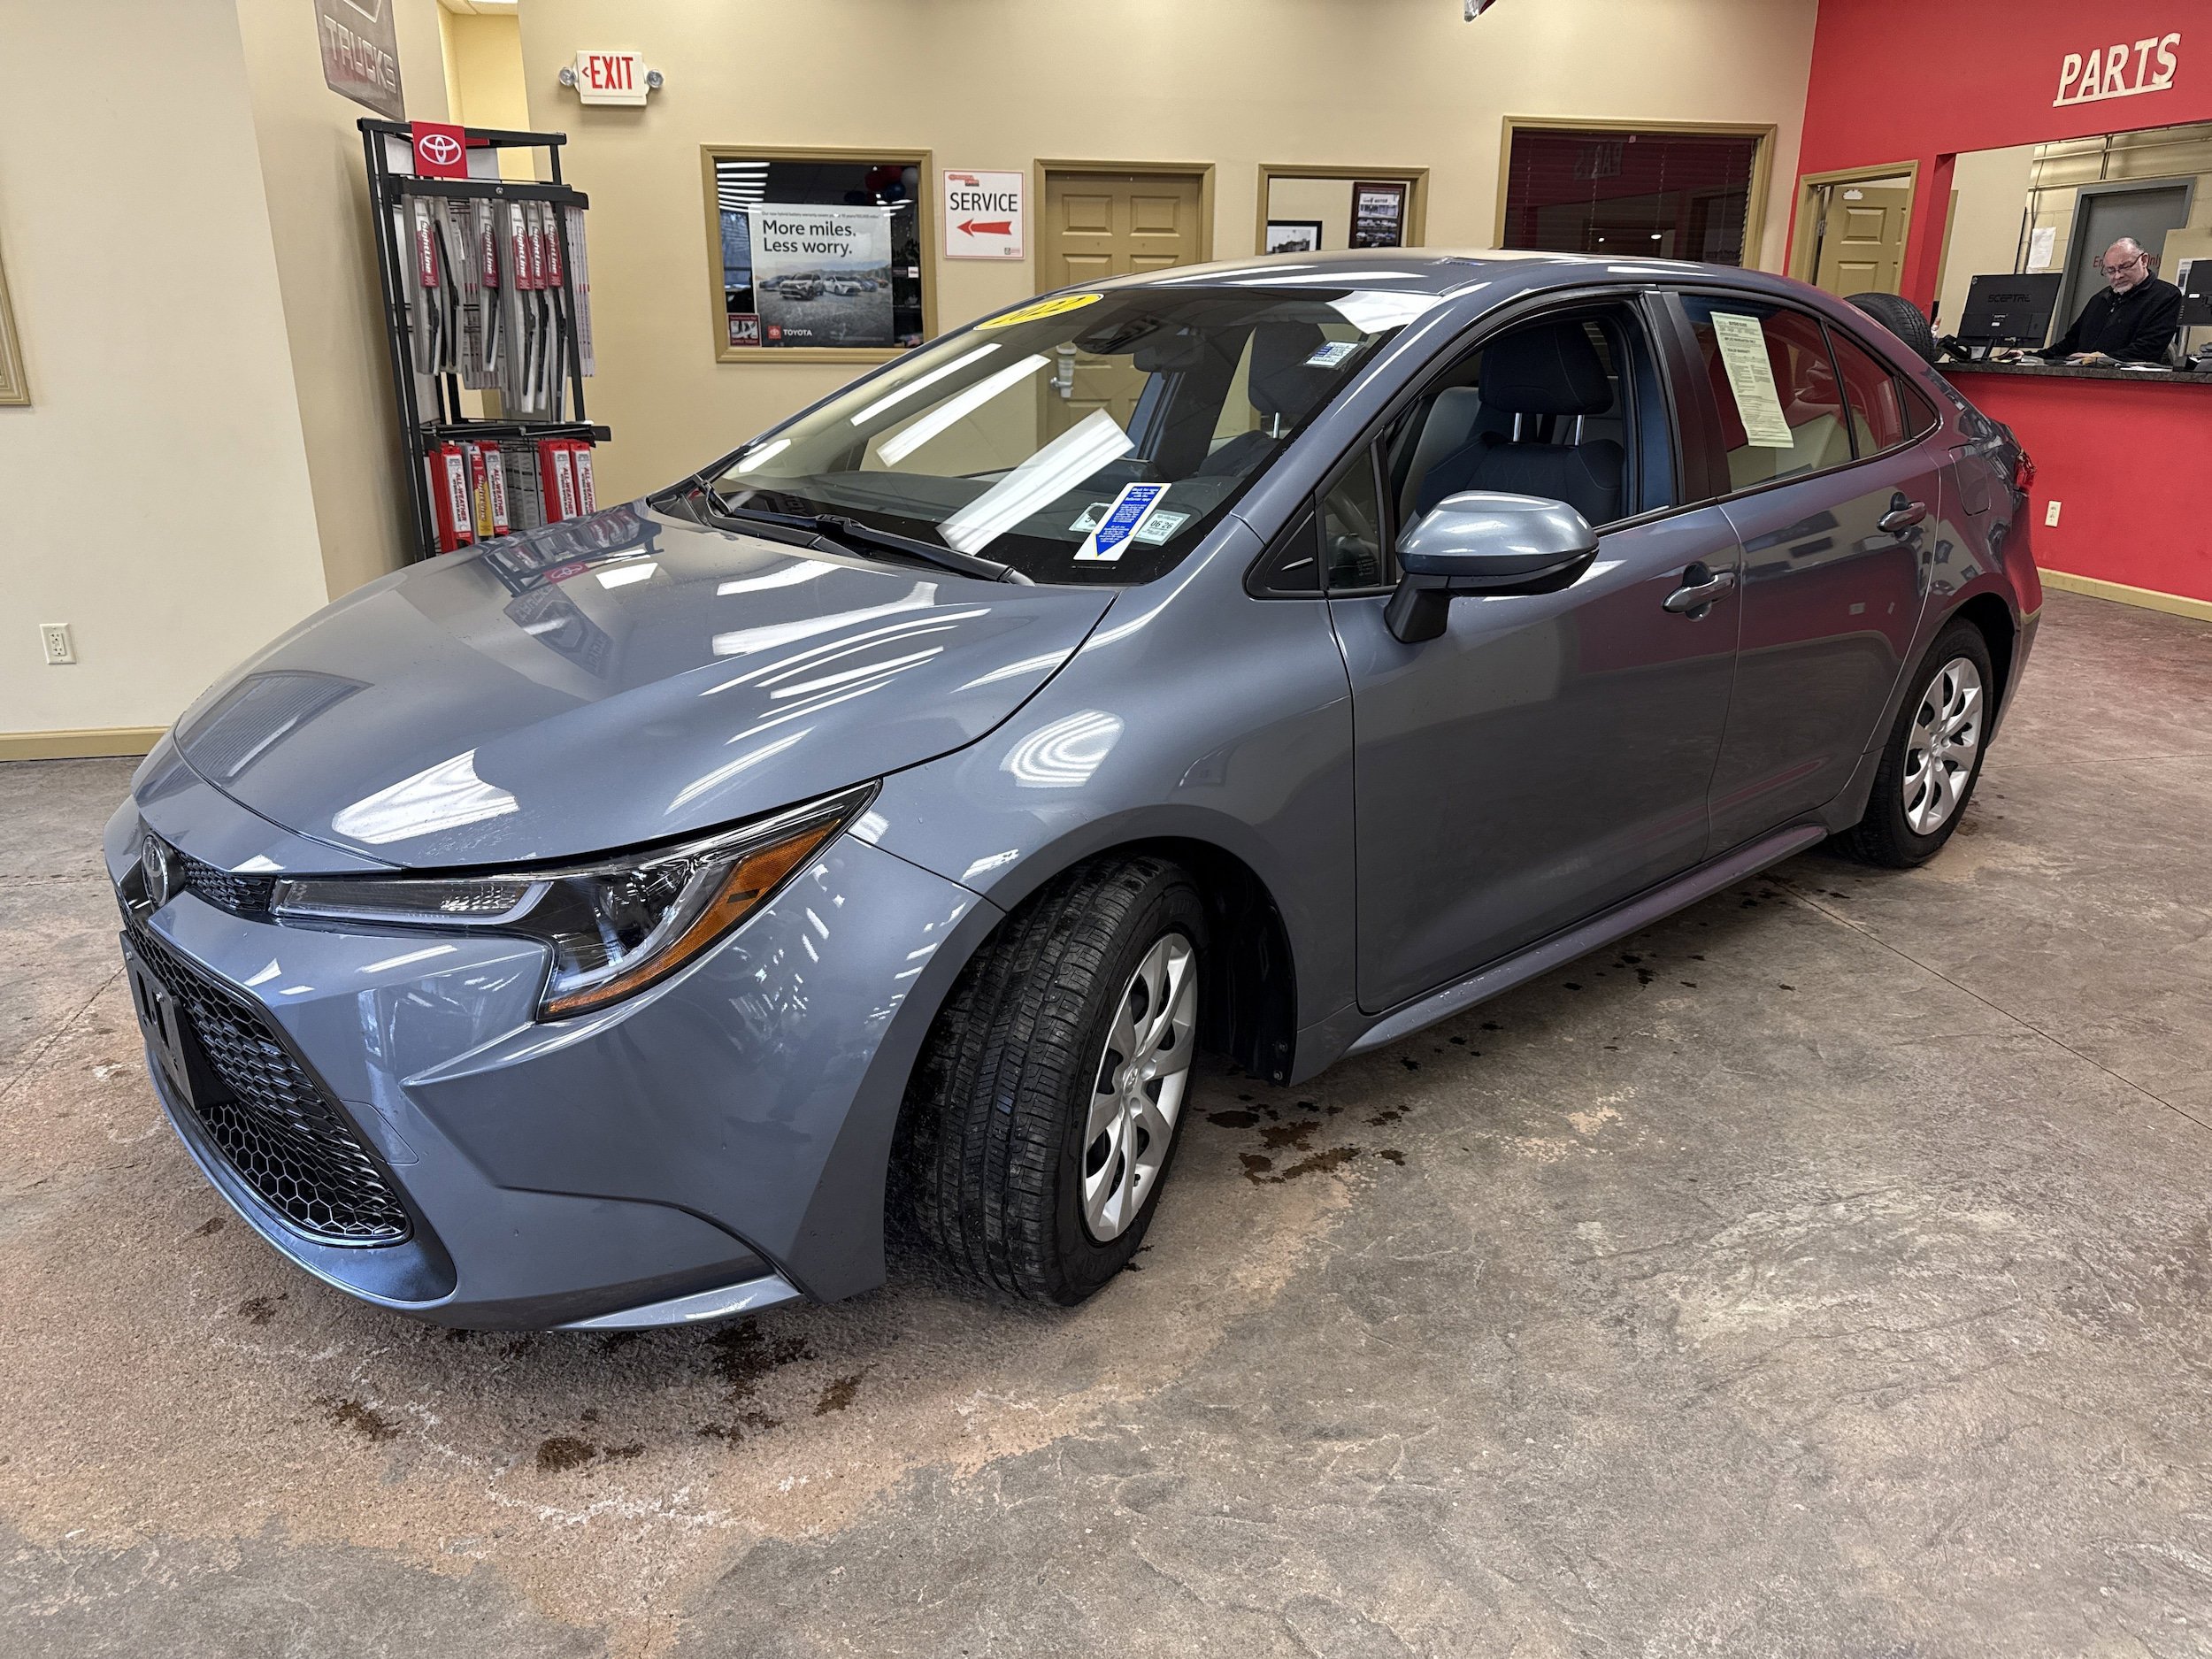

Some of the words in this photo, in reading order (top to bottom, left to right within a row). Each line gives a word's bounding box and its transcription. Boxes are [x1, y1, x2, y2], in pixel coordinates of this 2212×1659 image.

[323, 14, 396, 94] TRUCKS
[589, 56, 634, 90] EXIT
[2055, 32, 2182, 103] PARTS
[949, 192, 1018, 212] SERVICE
[420, 220, 432, 274] SightLine
[517, 226, 526, 278] SightLine
[763, 219, 805, 234] More
[810, 221, 856, 237] miles.
[764, 237, 798, 252] Less
[803, 242, 852, 257] worry.
[456, 472, 467, 521] ALL-WEATHER
[494, 468, 504, 516] ALL-WEATHER
[563, 467, 573, 514] ALL-WEATHER
